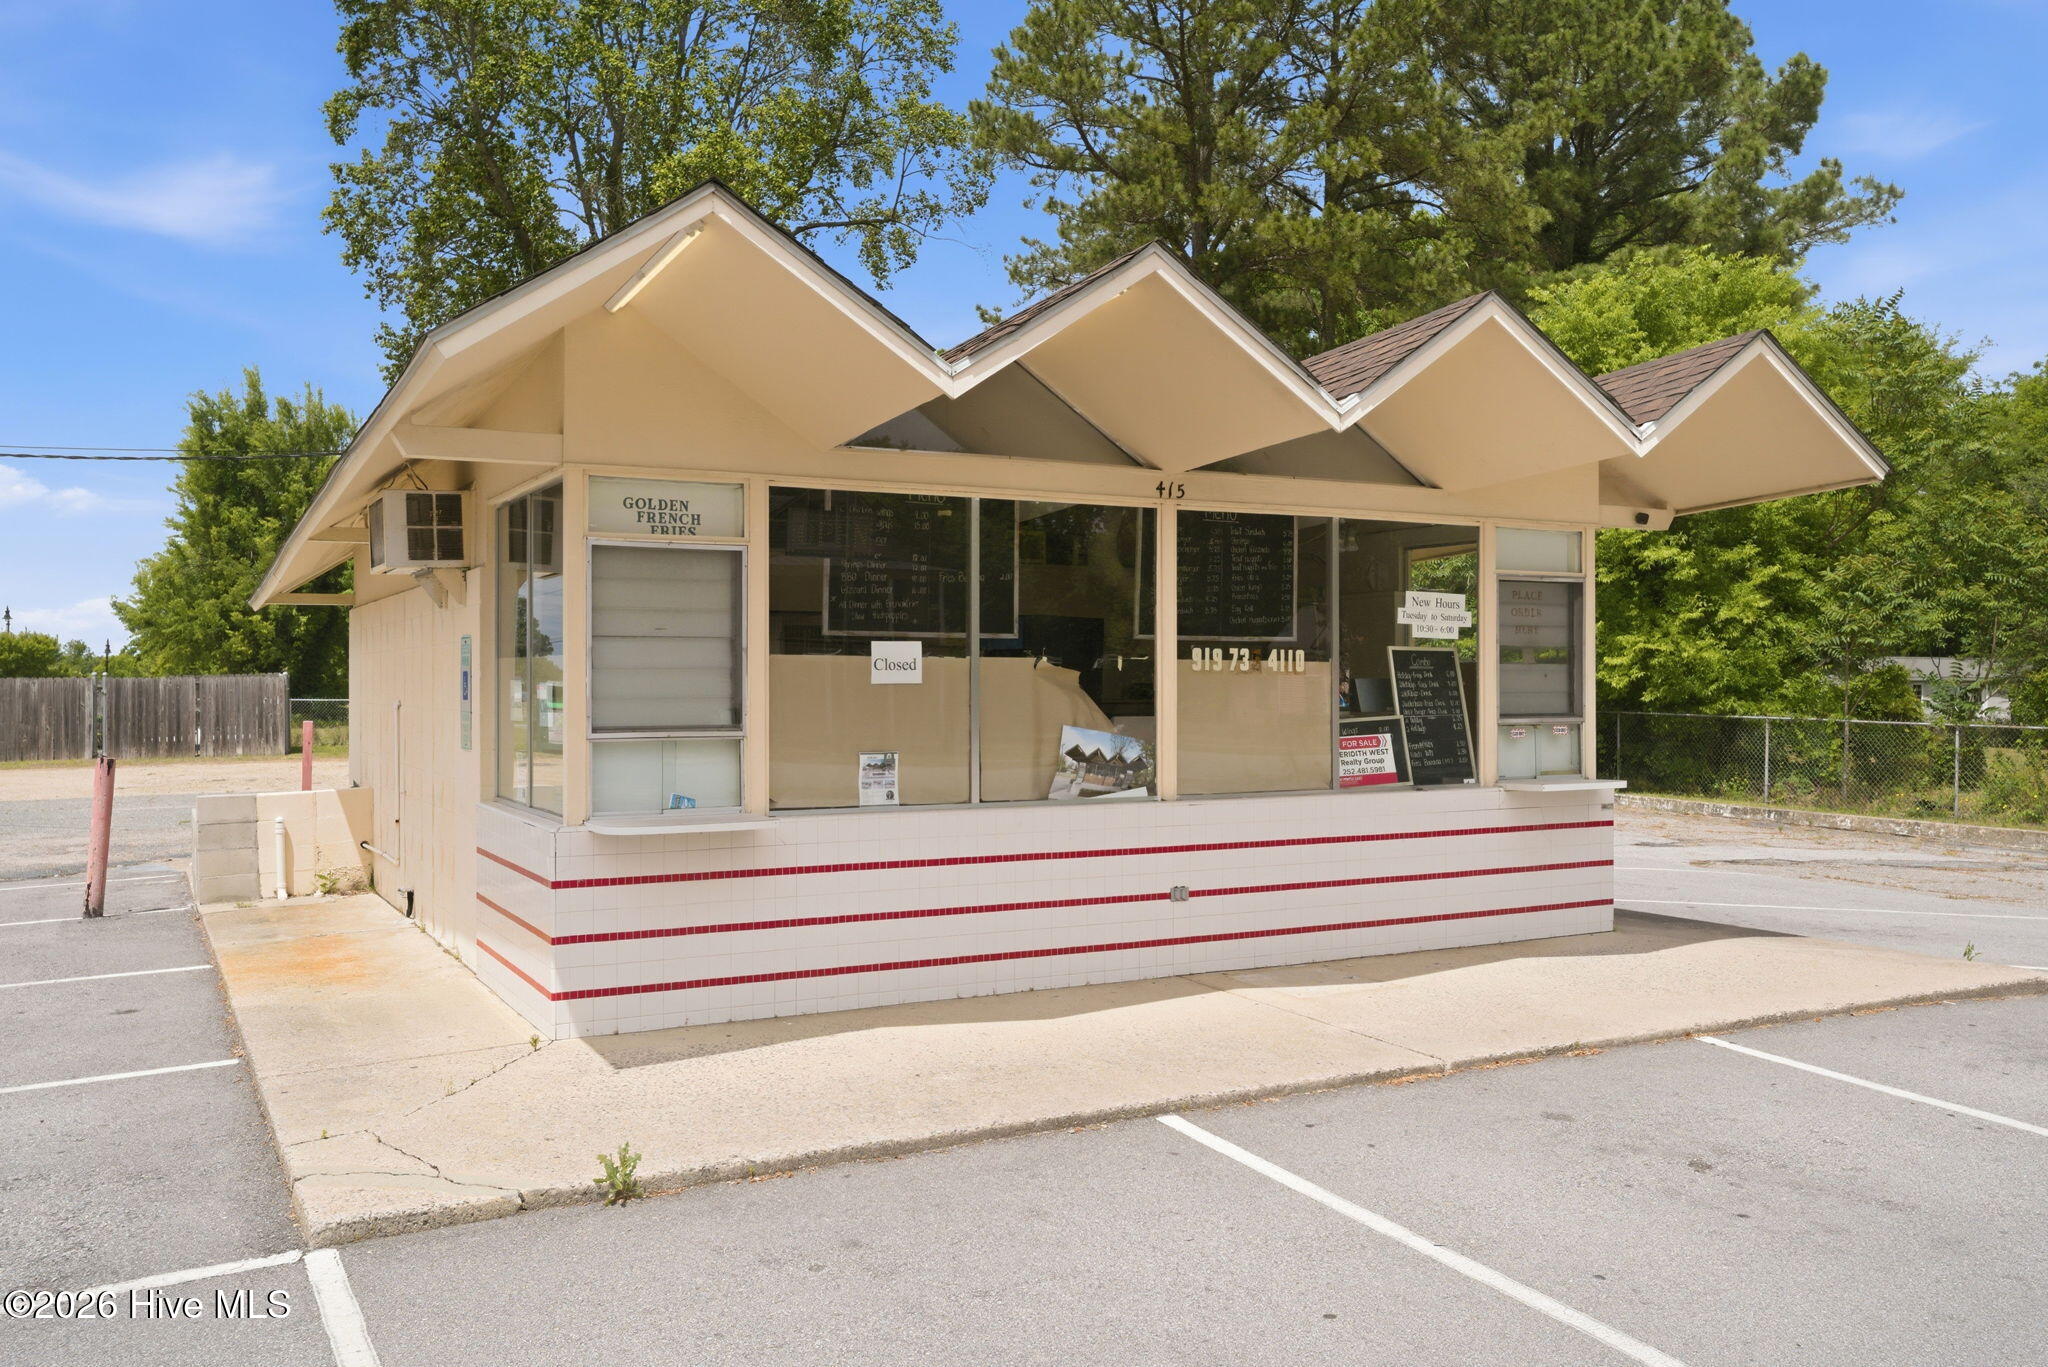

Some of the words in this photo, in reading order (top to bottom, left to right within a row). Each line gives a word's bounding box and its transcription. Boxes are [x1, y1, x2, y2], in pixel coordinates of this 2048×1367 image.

[1155, 480, 1185, 499] 415
[623, 497, 690, 512] GOLDEN
[636, 511, 702, 526] FRENCH
[651, 525, 697, 536] FRIES
[1512, 590, 1543, 600] PLACE
[1412, 596, 1431, 607] New
[1435, 597, 1460, 609] Hours
[1402, 610, 1428, 622] Tuesday
[1430, 612, 1438, 621] to
[1440, 613, 1468, 624] Saturday
[873, 657, 917, 671] Closed
[1192, 647, 1223, 672] 919
[1267, 648, 1305, 673] 4110
[1342, 740, 1358, 748] FOR
[1363, 757, 1385, 765] Group
